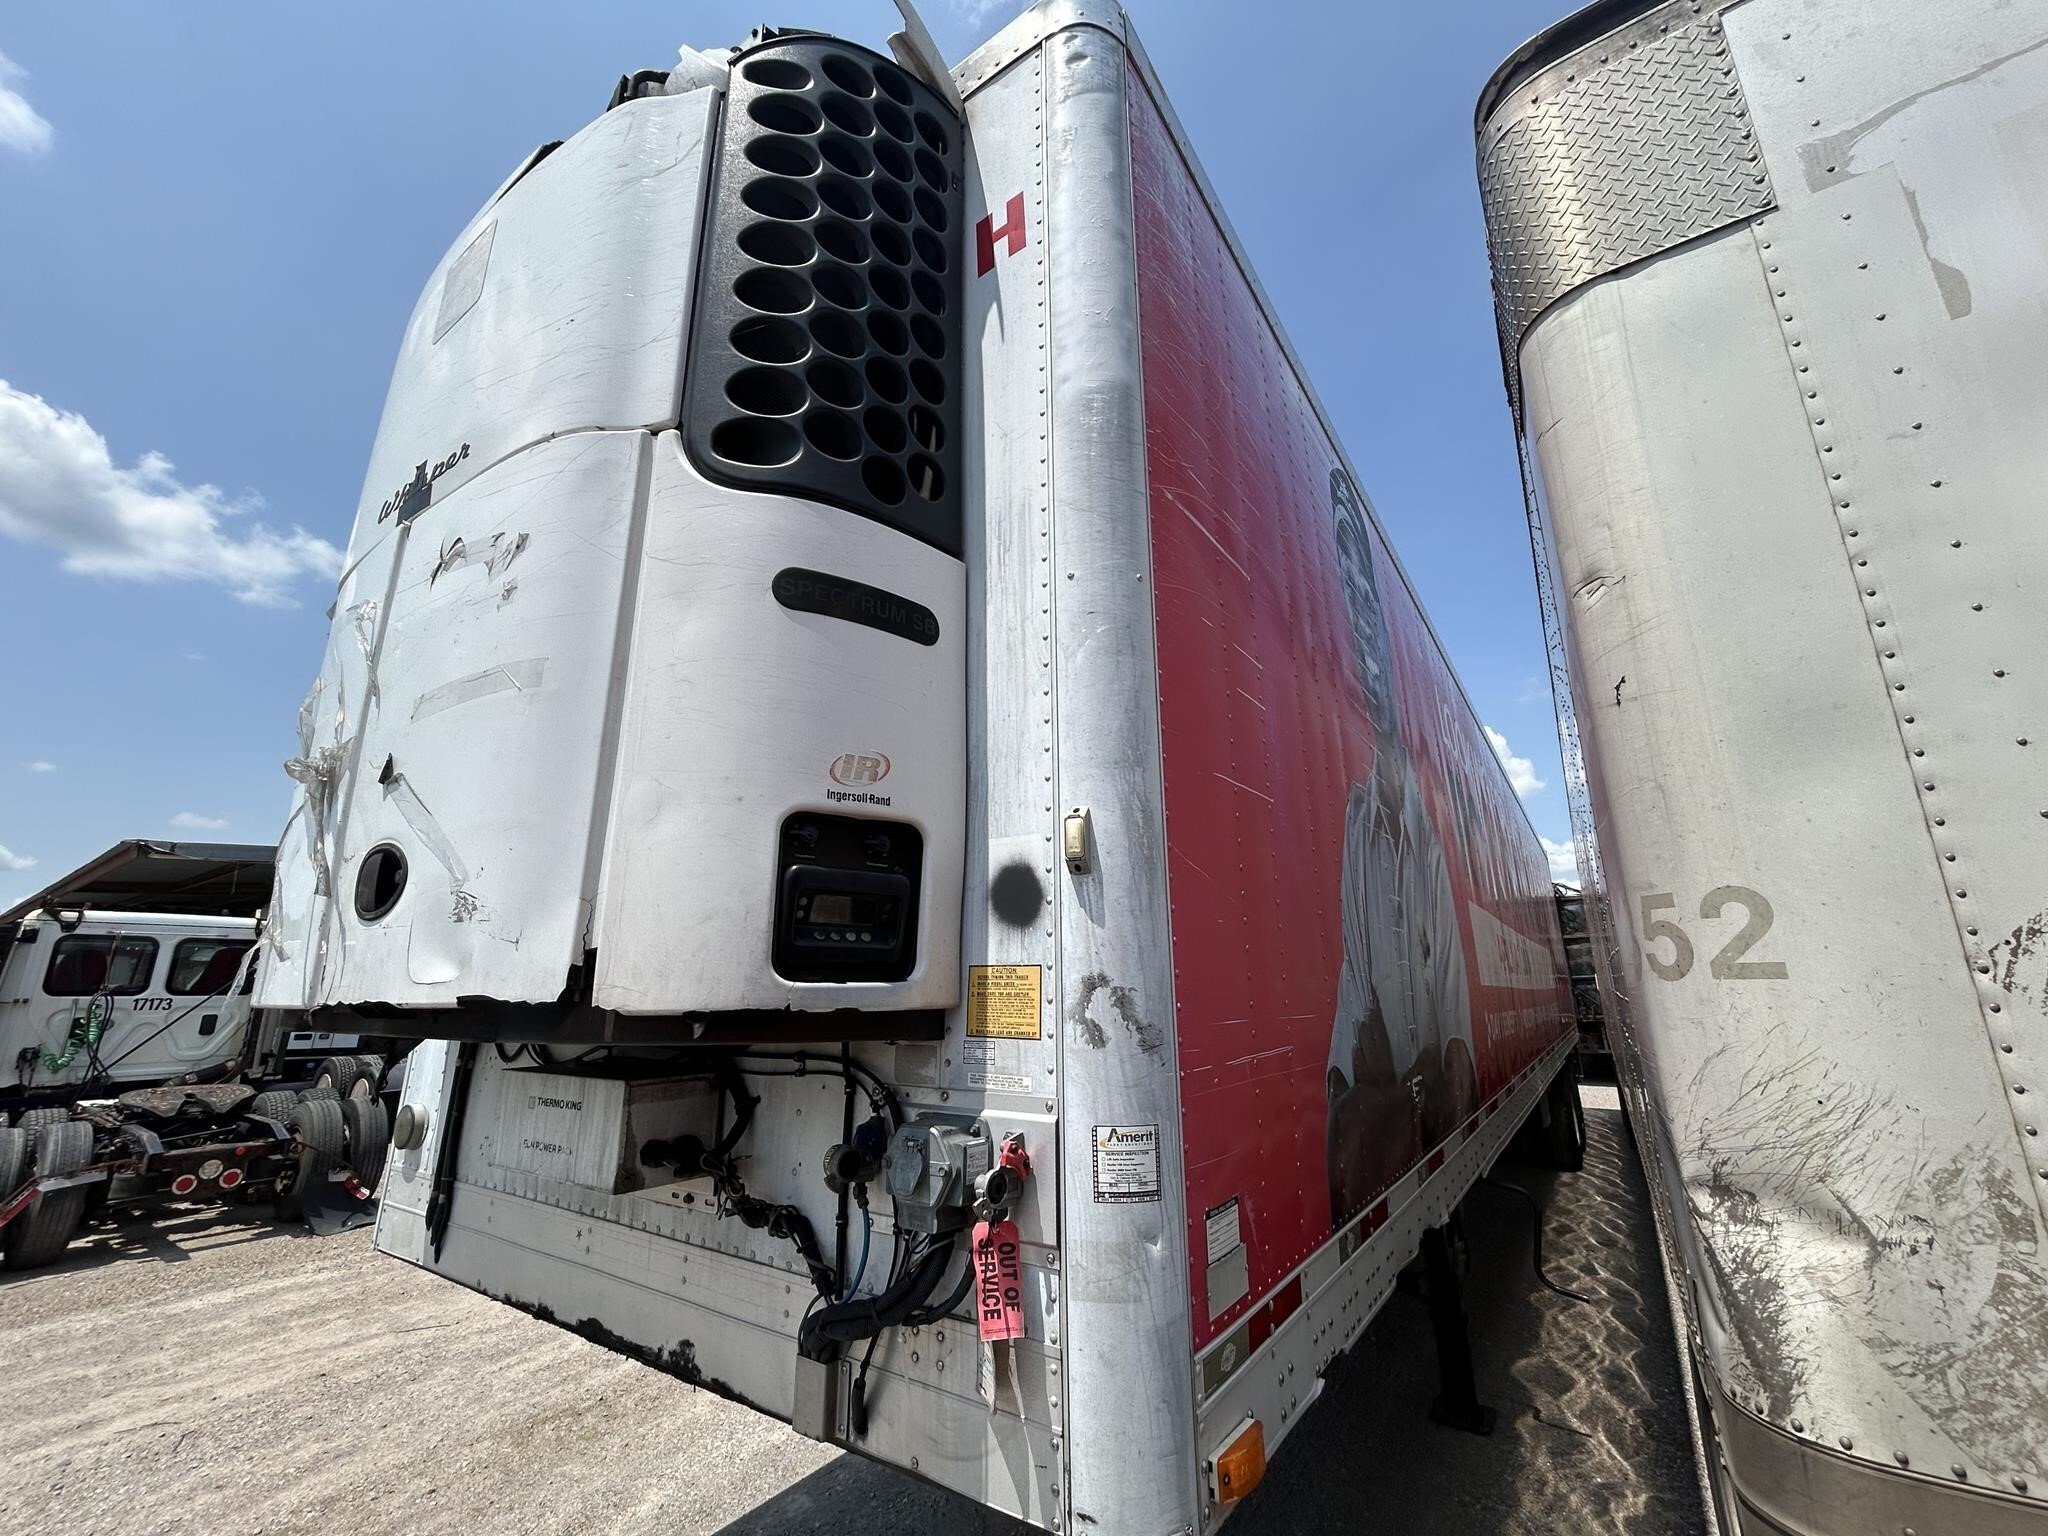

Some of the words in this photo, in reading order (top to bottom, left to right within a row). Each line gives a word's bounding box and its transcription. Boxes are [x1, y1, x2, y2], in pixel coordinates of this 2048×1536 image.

[976, 191, 1026, 278] H
[780, 577, 906, 625] SPECTRUM
[912, 613, 936, 635] SB
[840, 753, 881, 782] IR
[1640, 885, 1789, 982] 52
[991, 967, 1017, 975] CAUTION
[132, 997, 173, 1011] 17173
[537, 1097, 564, 1109] THERMO
[565, 1100, 582, 1111] KING
[535, 1141, 556, 1153] POWER
[1107, 1127, 1153, 1143] Amerit
[998, 1242, 1018, 1281] OUT
[978, 1237, 1002, 1321] SERVICE
[1004, 1287, 1020, 1312] OF
